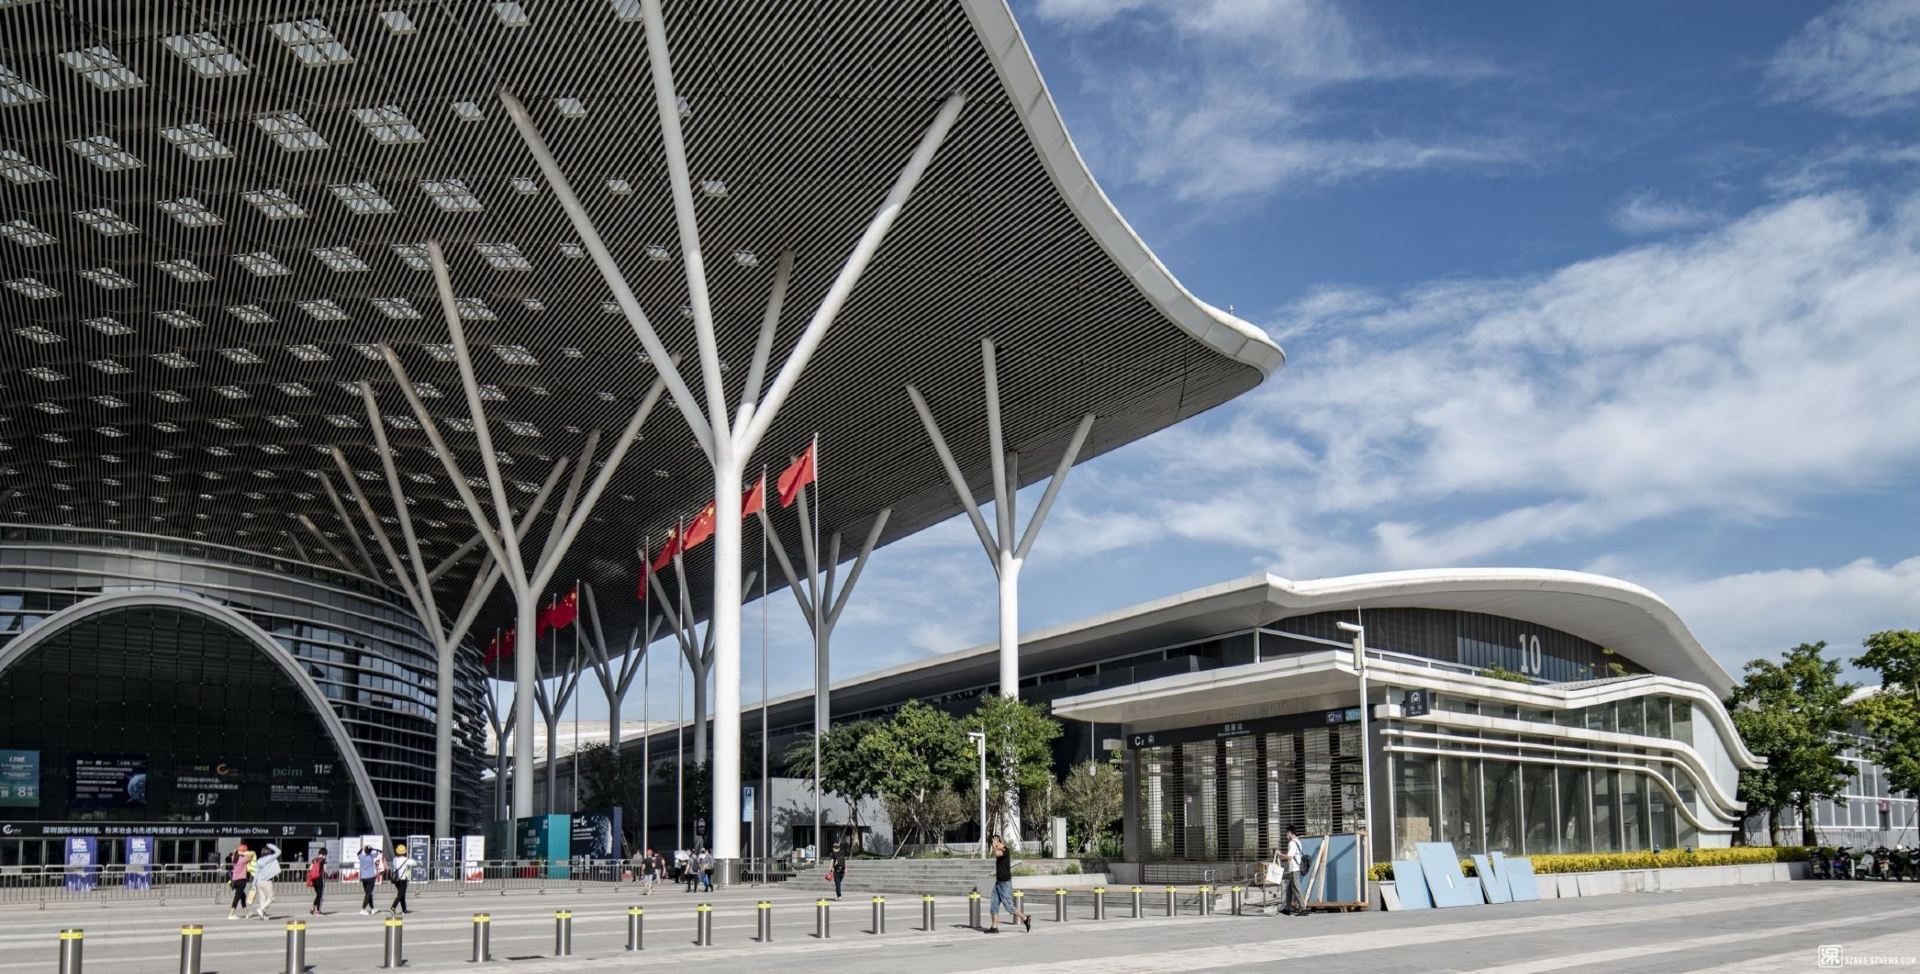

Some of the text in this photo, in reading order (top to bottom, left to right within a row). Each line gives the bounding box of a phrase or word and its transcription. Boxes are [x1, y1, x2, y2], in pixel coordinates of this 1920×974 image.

[1519, 633, 1541, 675] 10
[314, 763, 323, 775] 11
[17, 786, 26, 797] 8
[197, 792, 206, 806] 9
[282, 825, 288, 836] 9
